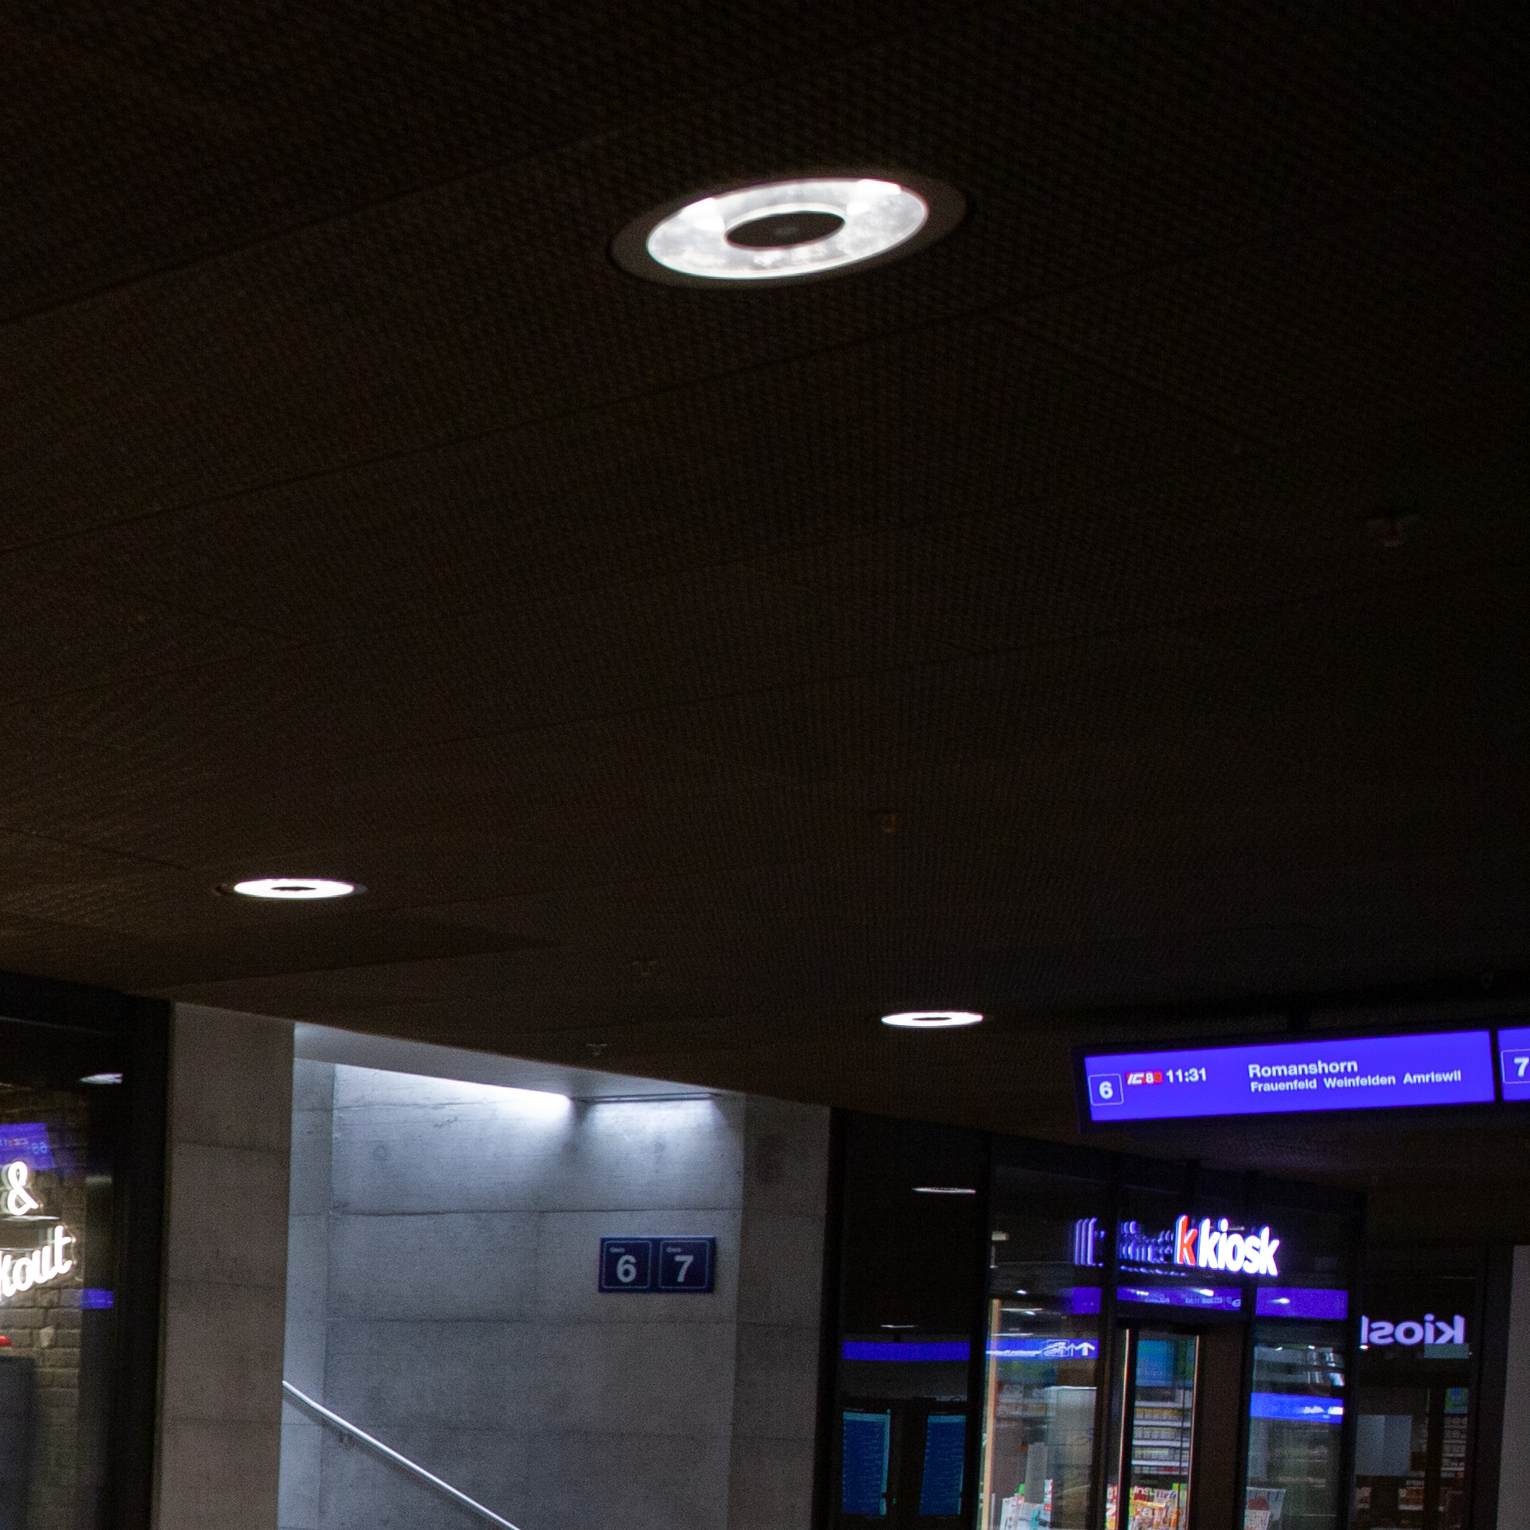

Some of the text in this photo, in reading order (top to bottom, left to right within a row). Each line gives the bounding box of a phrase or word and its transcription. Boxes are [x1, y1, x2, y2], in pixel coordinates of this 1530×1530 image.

[1145, 1072, 1155, 1084] 8
[1166, 1067, 1207, 1084] 11:31
[1248, 1059, 1359, 1079] Romanshorn
[1513, 1056, 1530, 1077] 7
[1098, 1081, 1114, 1099] 6
[1250, 1069, 1462, 1093] Frauenfeld Weinfelden Amriswil
[5, 1160, 39, 1216] &
[1198, 1216, 1281, 1277] kiosk
[616, 1254, 694, 1283] 6 7
